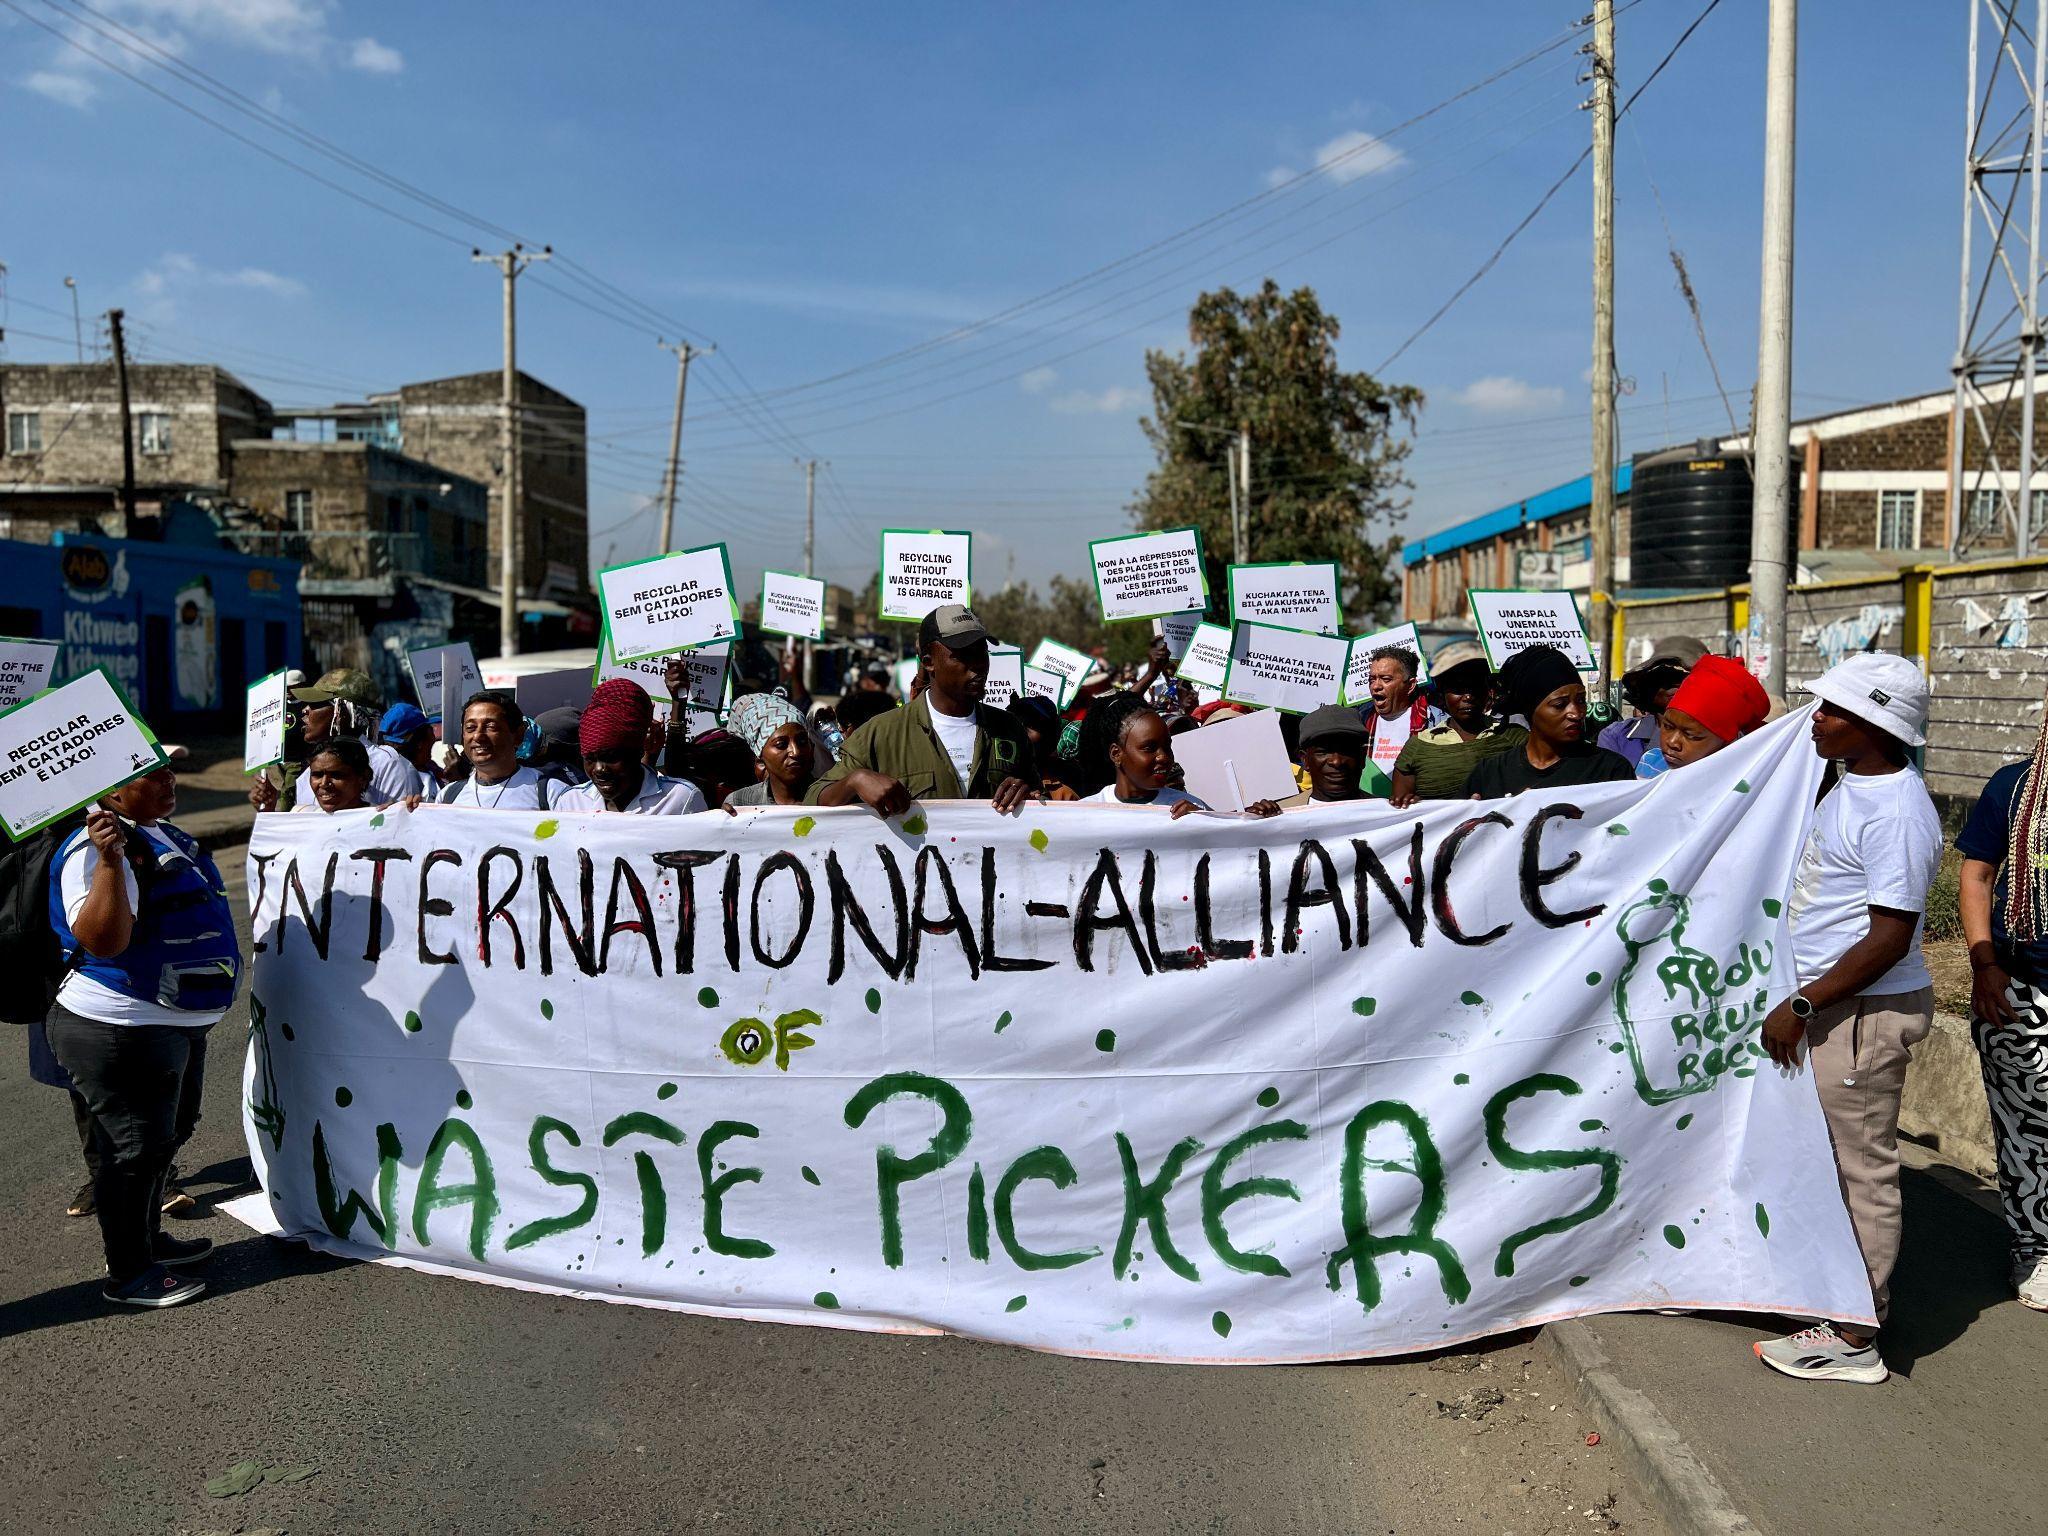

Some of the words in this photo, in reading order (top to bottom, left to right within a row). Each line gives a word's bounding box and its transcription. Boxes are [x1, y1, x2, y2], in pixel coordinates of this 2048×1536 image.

[899, 552, 952, 564] RECYCLING
[1097, 560, 1117, 569] NON
[1126, 556, 1138, 564] LA
[903, 565, 947, 575] WITHOUT
[1107, 567, 1124, 576] DES
[1125, 563, 1158, 574] PLACES
[1172, 558, 1190, 567] DES
[889, 576, 920, 586] WASTE
[922, 577, 963, 588] PICKERS
[1103, 572, 1146, 585] MARCHÉS
[1148, 569, 1171, 579] POUR
[1173, 566, 1196, 576] TOUS
[633, 580, 698, 602] RECICLAR
[1124, 582, 1140, 591] LES
[1141, 577, 1178, 589] BIFFINS
[897, 588, 906, 596] IS
[909, 588, 953, 599] GARBAGE
[1116, 585, 1189, 601] RÉCUPÉRATEURS
[1245, 590, 1300, 599] KUCHAKATA
[1302, 589, 1325, 597] TENA
[614, 605, 642, 619] SEM
[644, 588, 723, 612] CATADORES
[775, 605, 789, 613] TAKA
[1241, 600, 1262, 608] BILA
[1264, 597, 1330, 607] WAKUSANYAJI
[646, 613, 655, 624] É
[657, 606, 693, 622] LIXO!
[1255, 607, 1279, 615] TAKA
[1294, 606, 1318, 614] TAKA
[1498, 610, 1558, 618] UMASPALA
[1506, 620, 1557, 628] UNEMALI
[1486, 630, 1546, 639] YOKUGADA
[1548, 630, 1582, 638] UDOTI
[1202, 651, 1226, 661] WAKUSAN
[1246, 651, 1304, 668] KUCHAKATA
[1306, 661, 1332, 672] TENA
[1, 662, 18, 671] OF
[21, 662, 44, 673] THE
[662, 655, 718, 676] PKERS
[1043, 663, 1071, 677] WITHOUT
[1044, 655, 1077, 672] RECYCLING
[1240, 658, 1262, 669] BILA
[1264, 661, 1335, 681] WAKUSANYAJI
[1348, 664, 1372, 676] ARCH
[0, 673, 26, 685] ION,
[641, 664, 703, 685] GARGE
[1252, 669, 1278, 680] TAKA
[1279, 674, 1291, 683] NI
[1294, 677, 1319, 687] TAKA
[0, 685, 16, 694] HE
[1039, 685, 1054, 694] THE
[7, 714, 91, 763] RECICLAR
[28, 713, 125, 769] CATADORES
[36, 768, 50, 783] É
[49, 745, 96, 776] LIXO!
[718, 1008, 823, 1072] OF
[312, 1110, 776, 1262] WASTE
